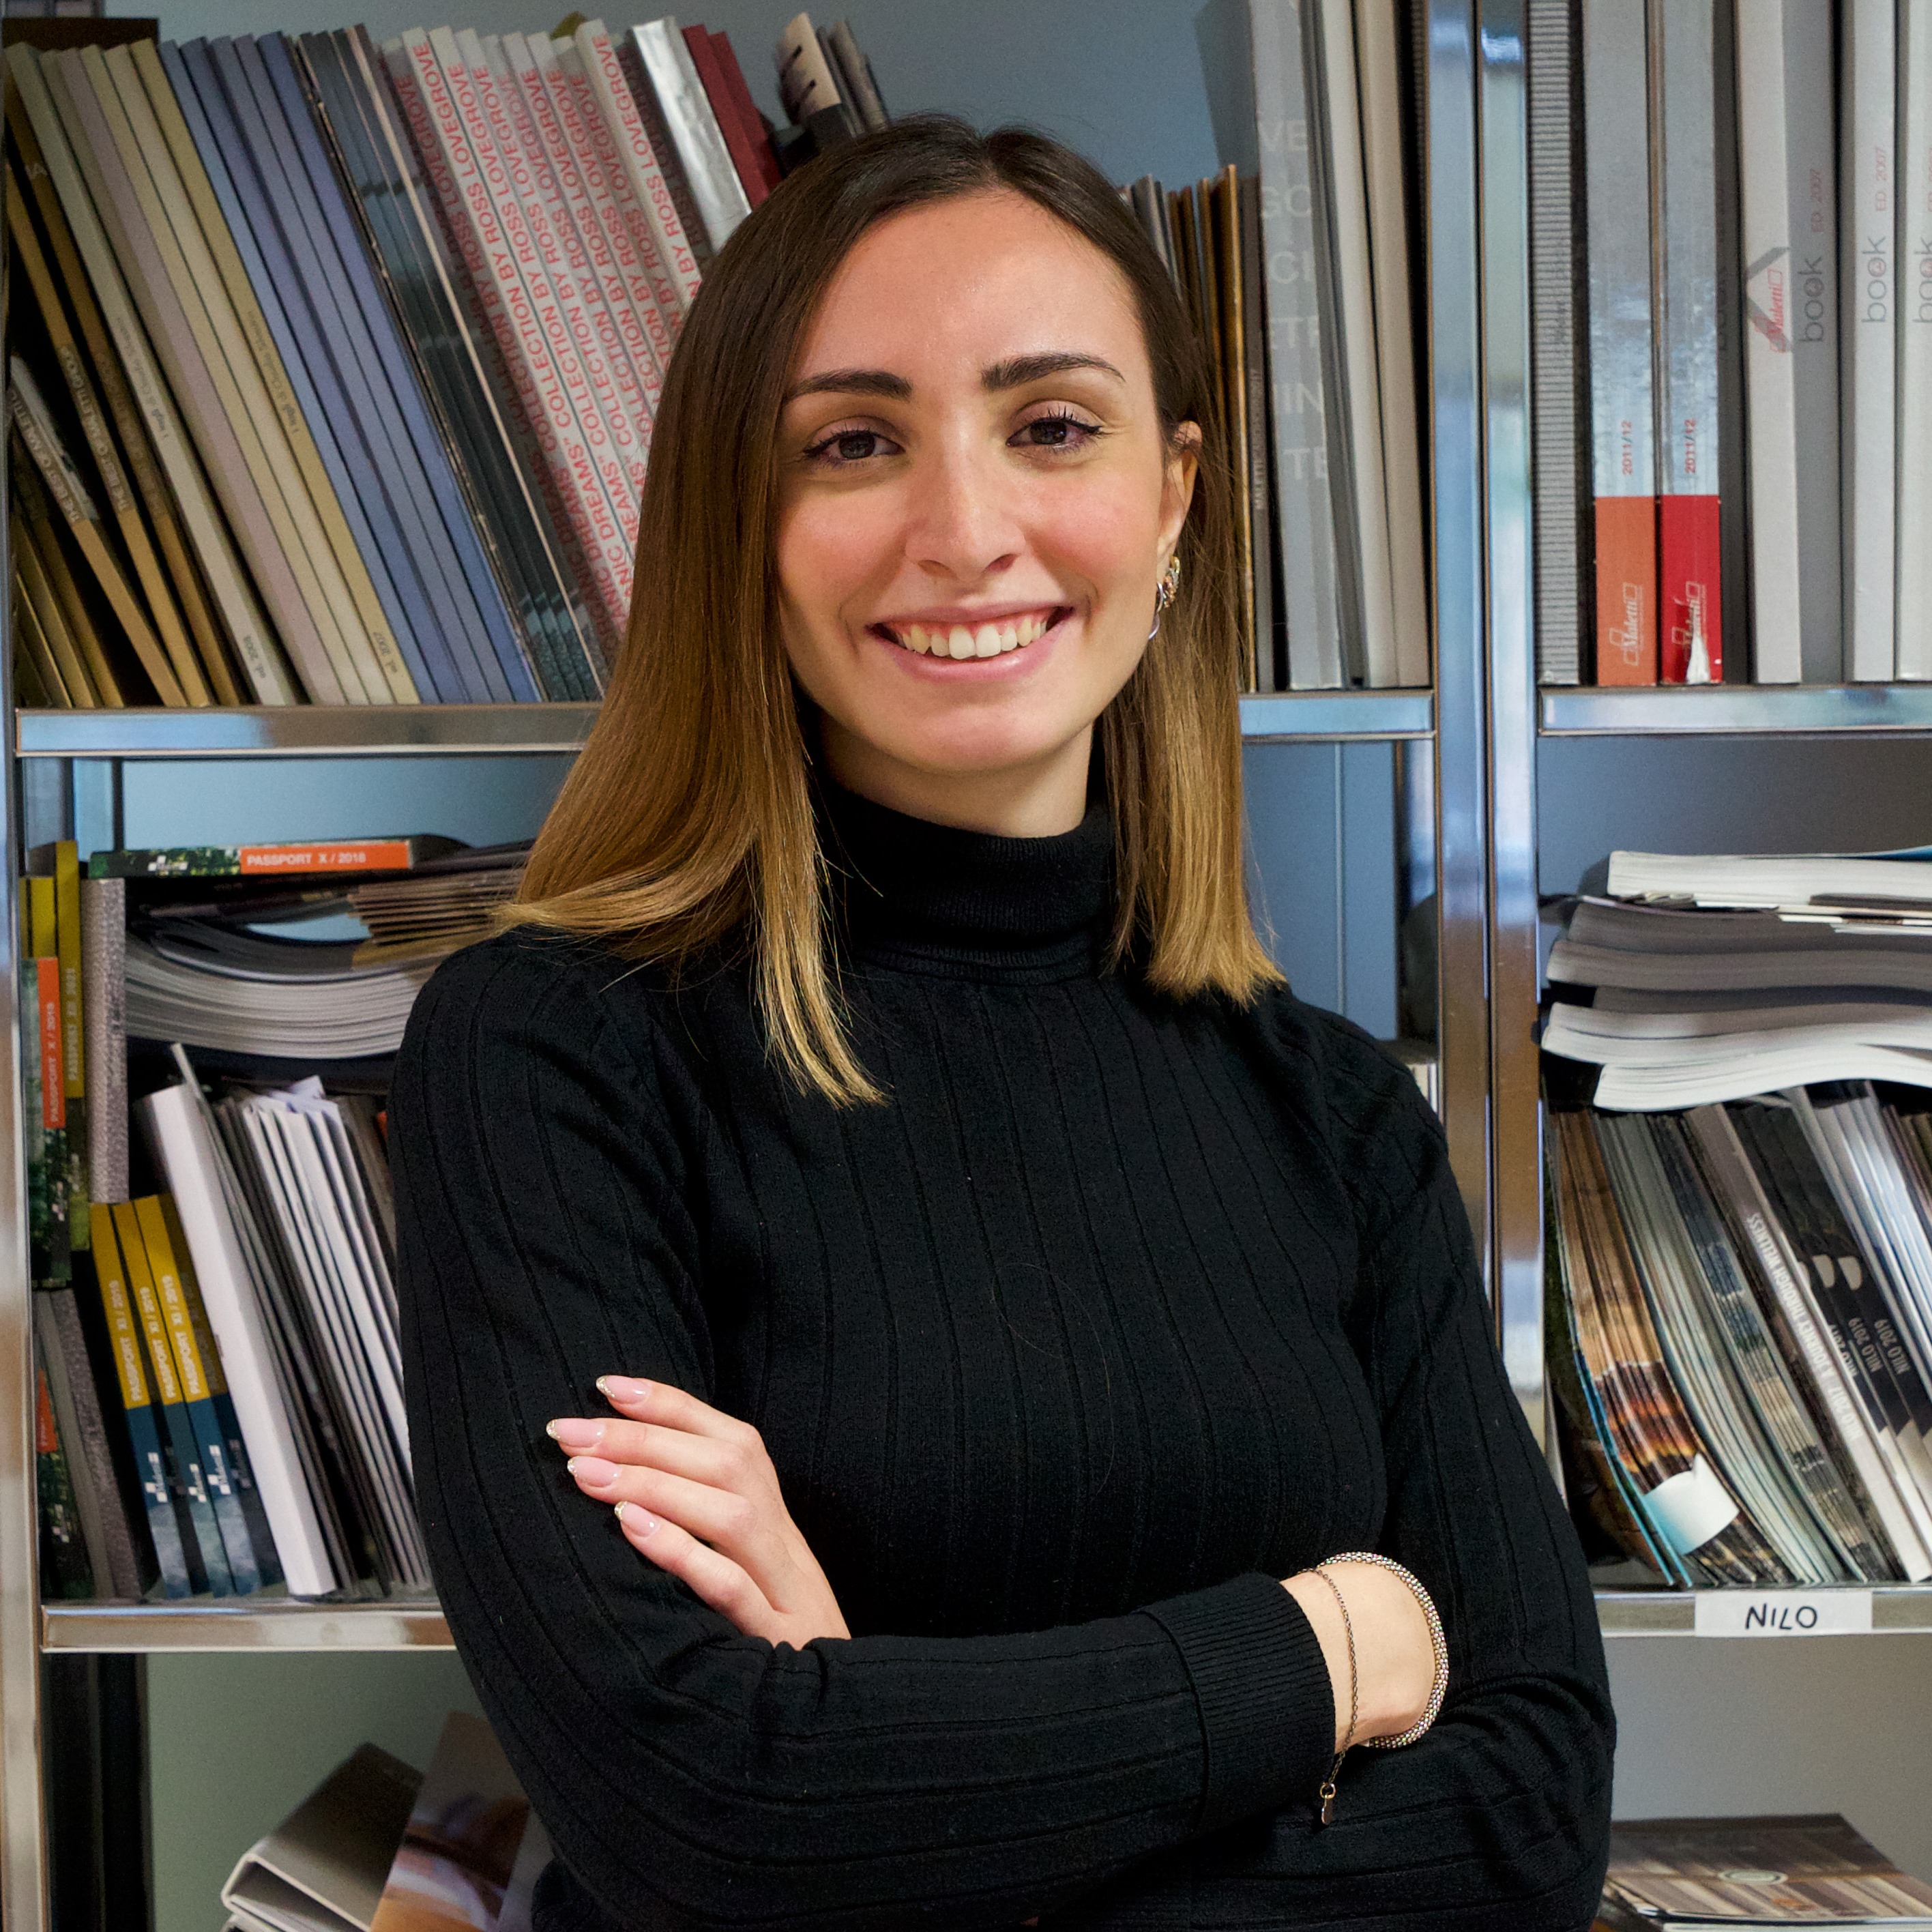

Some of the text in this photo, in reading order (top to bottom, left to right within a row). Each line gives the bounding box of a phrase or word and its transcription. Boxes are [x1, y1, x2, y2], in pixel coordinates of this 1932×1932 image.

[411, 39, 478, 179] LOVEGROVE
[445, 61, 511, 198] LOVEGROVE
[590, 31, 656, 171] LOVEGROVE
[496, 69, 561, 205] LOVEGROVE
[520, 66, 585, 203] LOVEGROVE
[569, 70, 634, 205] LOVEGROVE
[464, 180, 502, 245] ROSS
[544, 66, 651, 302] BY ROSS LOVEGROVE
[644, 173, 681, 238] ROSS
[471, 63, 634, 448] COLLECTION BY ROSS LOVEGROVE
[491, 248, 516, 281] BY
[500, 201, 536, 264] ROSS
[550, 206, 587, 270] ROSS
[574, 204, 611, 268] ROSS
[622, 205, 660, 270] ROSS
[671, 241, 695, 274] BY
[525, 267, 550, 300] BY
[577, 273, 602, 305] BY
[601, 271, 625, 302] BY
[650, 274, 675, 305] BY
[1798, 257, 1824, 342] book
[1861, 236, 1887, 323] book
[504, 284, 573, 430] COLLECTION
[540, 302, 608, 448] COLLECTION
[1621, 420, 1632, 475] 2011/12
[1684, 418, 1696, 473] 2011/12
[246, 853, 311, 867] PASSPORT
[318, 853, 327, 865] X
[338, 851, 366, 864] 2018
[46, 1056, 60, 1122] PASSPORT
[118, 1335, 143, 1402] PASSPORT
[151, 1336, 178, 1399] PASSPORT
[174, 1328, 203, 1395] PASSPORT
[1846, 1315, 1884, 1373] NILO 2019
[1873, 1316, 1911, 1375] NILO 2019
[1745, 1603, 1817, 1629] NILO
